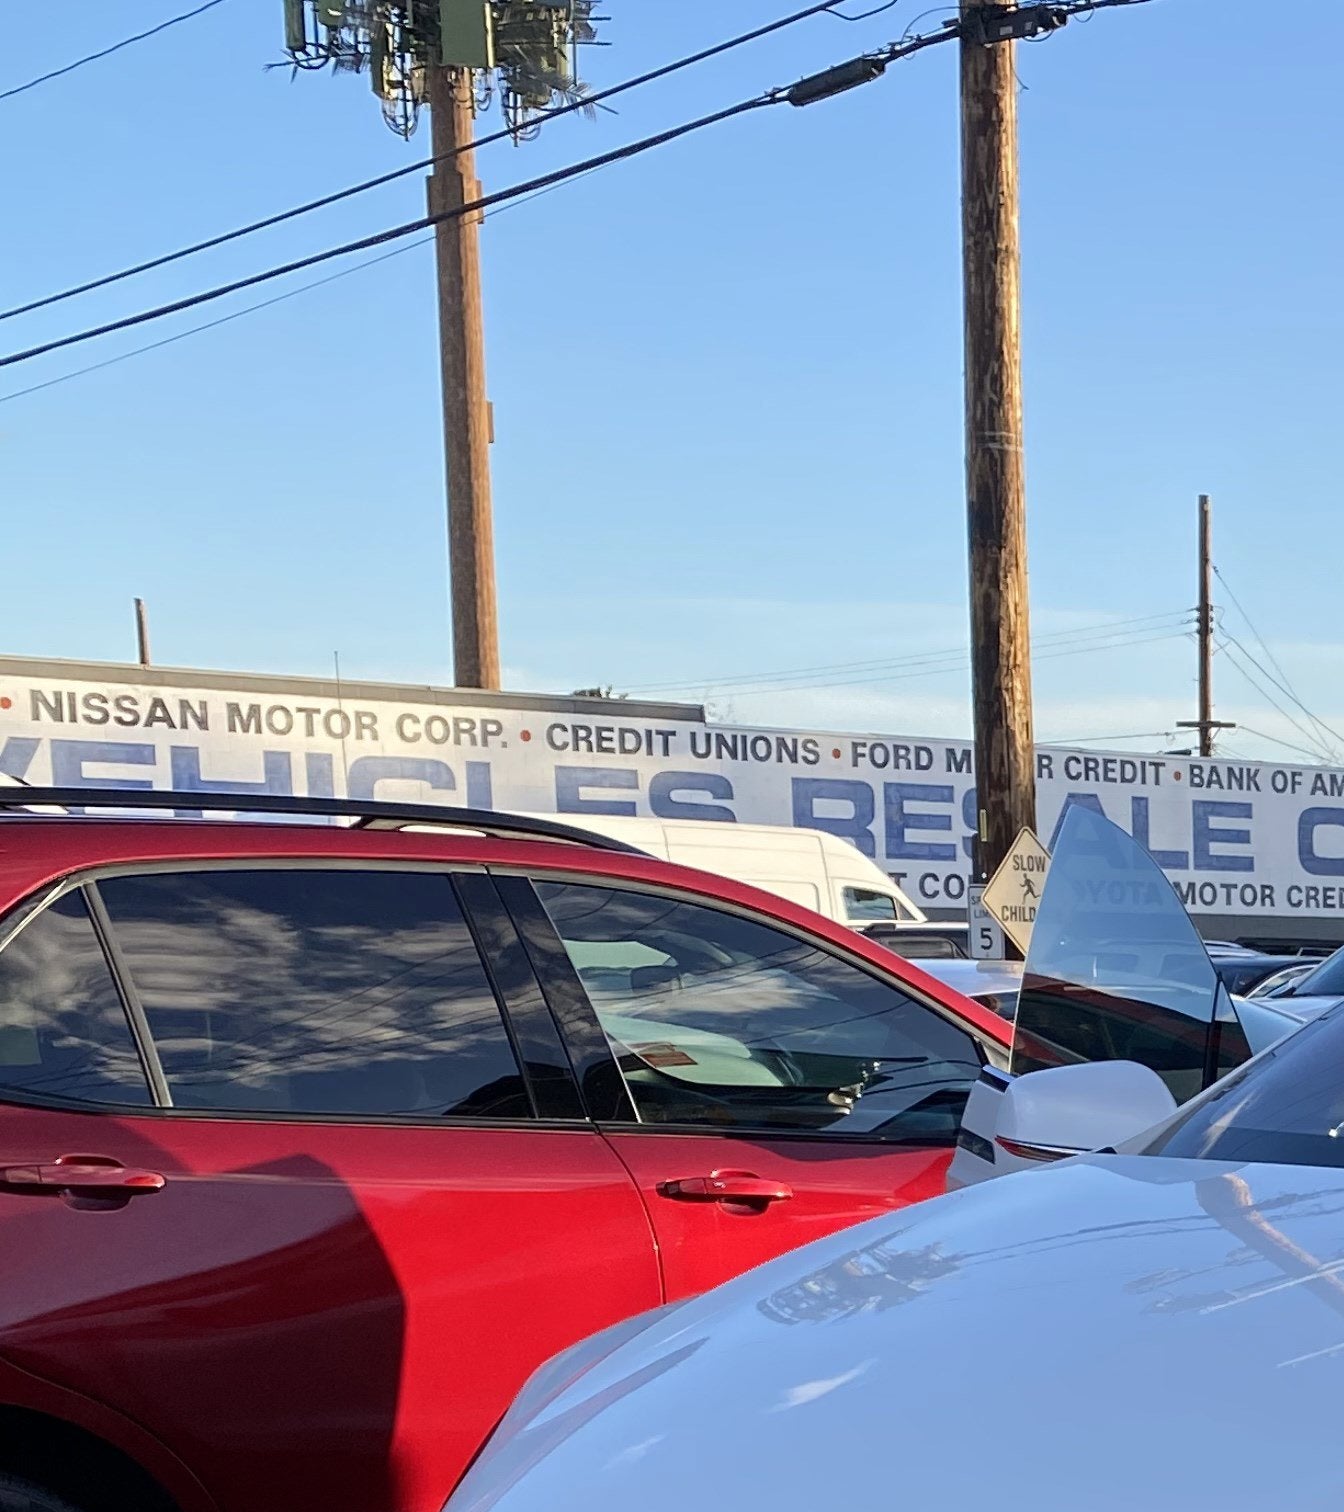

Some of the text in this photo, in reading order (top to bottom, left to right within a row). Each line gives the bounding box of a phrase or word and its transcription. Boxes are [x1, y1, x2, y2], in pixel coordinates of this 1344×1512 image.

[30, 689, 508, 749] NISSAN MOTOR CORP.
[545, 722, 820, 766] CREDIT UNIONS
[851, 741, 934, 771] FORD
[1063, 755, 1166, 786] CREDIT
[1188, 763, 1262, 793] BANK
[1270, 769, 1303, 795] OF
[790, 776, 1255, 872] REALE
[1012, 854, 1046, 873] SLOW
[1174, 881, 1275, 908] MOTOR
[980, 927, 993, 950] 5
